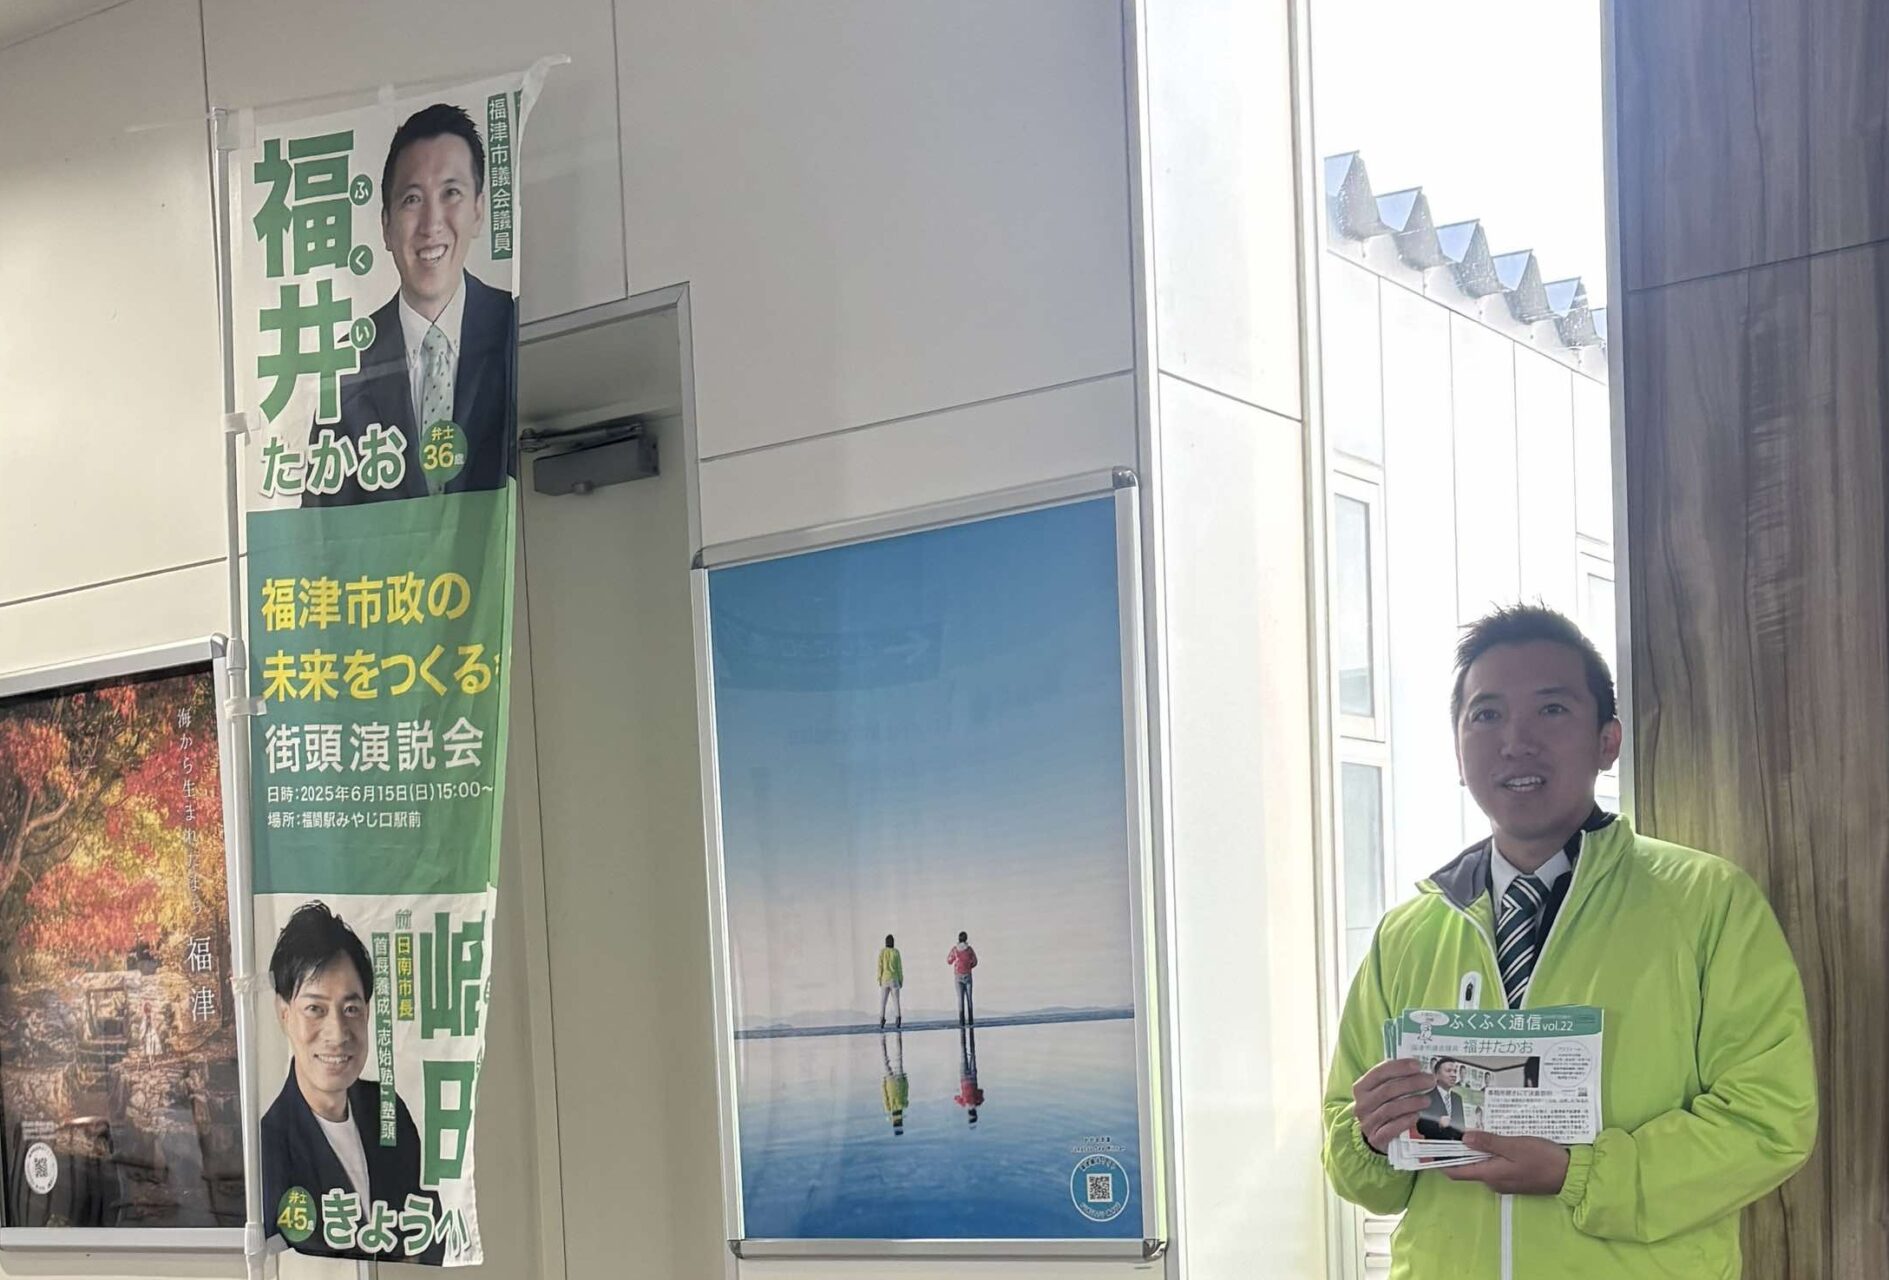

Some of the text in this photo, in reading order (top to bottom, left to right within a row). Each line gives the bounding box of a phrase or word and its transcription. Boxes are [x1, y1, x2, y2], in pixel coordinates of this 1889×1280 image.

[489, 98, 512, 253] 福津市議会議員
[253, 130, 356, 424] 福井
[261, 424, 405, 495] たかお
[261, 571, 472, 631] 福津市政の
[261, 643, 500, 702] 未来をつくる
[265, 716, 485, 774] 街頭演説会
[184, 936, 216, 1022] 福津
[1449, 1013, 1541, 1031] ふくふく通信
[1542, 1021, 1574, 1032] vol.22
[1463, 1039, 1534, 1054] 福井たかお
